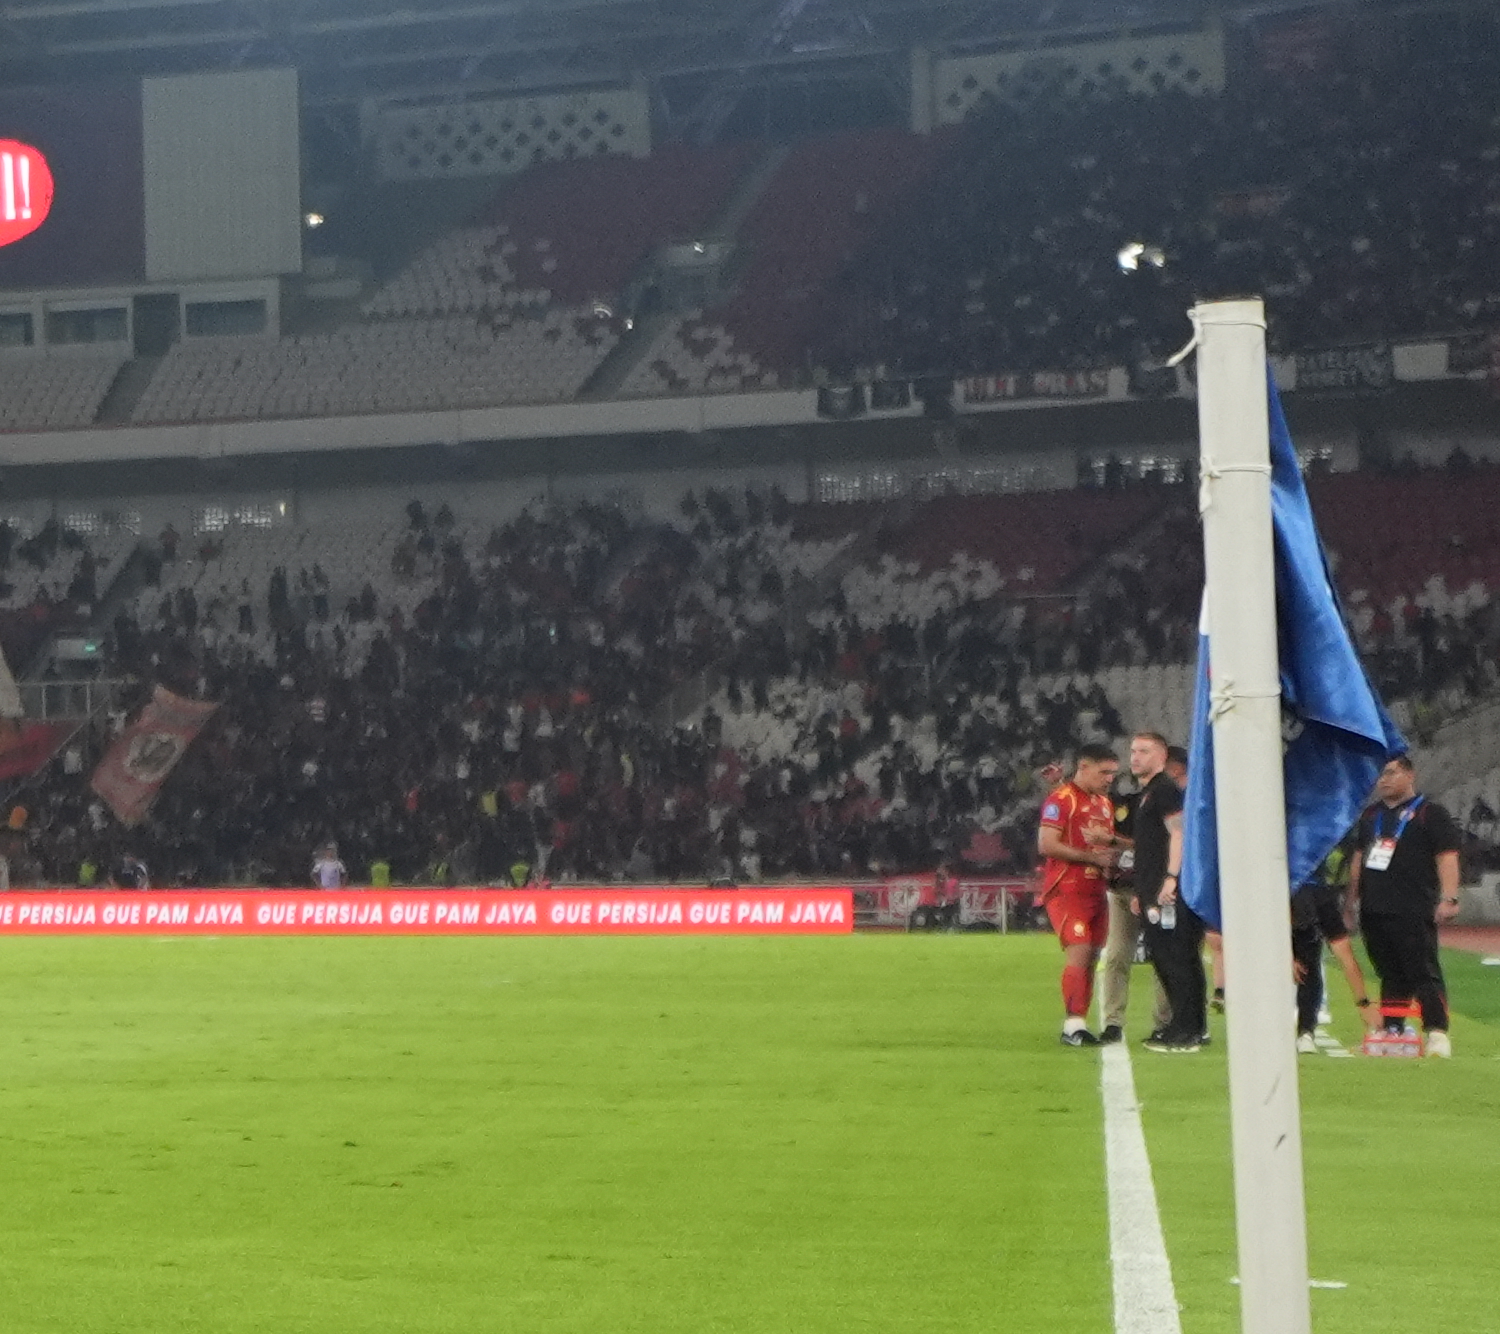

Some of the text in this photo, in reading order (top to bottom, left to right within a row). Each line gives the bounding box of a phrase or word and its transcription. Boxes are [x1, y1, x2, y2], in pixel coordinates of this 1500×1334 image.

[19, 904, 95, 924] PERSIJA
[103, 904, 141, 924] GUE
[146, 904, 189, 923] PAM
[194, 904, 243, 923] JAYA
[257, 903, 536, 924] GUE PERSIJA GUE PAM JAYA
[551, 902, 844, 923] GUE PERSIJA GUE PAM JAYA
